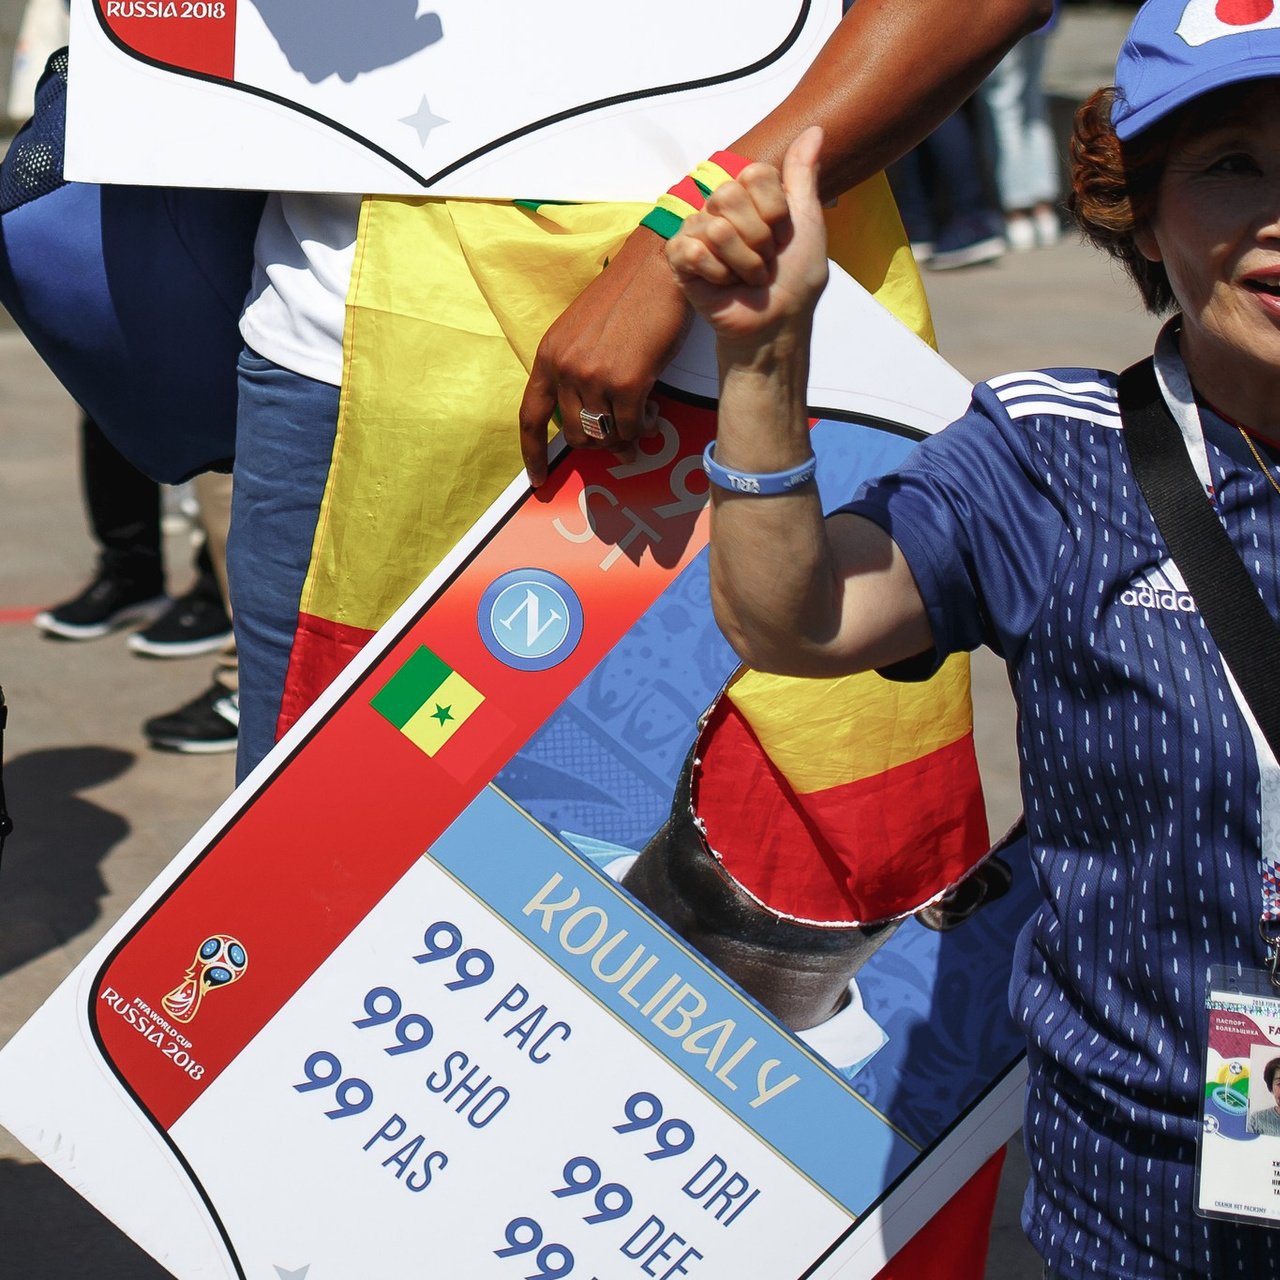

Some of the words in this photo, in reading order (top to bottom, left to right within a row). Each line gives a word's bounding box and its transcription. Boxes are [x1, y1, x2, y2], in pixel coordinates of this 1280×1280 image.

[107, 1, 178, 18] RUSSIA
[180, 1, 226, 19] 2018
[606, 416, 711, 519] 99
[551, 484, 663, 572] ST
[499, 588, 563, 648] N
[1120, 587, 1198, 613] adida
[100, 986, 166, 1048] RUSSIA
[161, 1041, 205, 1081] 2018
[133, 997, 152, 1017] FIFA
[148, 1010, 178, 1037] WORLD
[175, 1033, 193, 1049] CUP
[411, 920, 495, 992] 99
[484, 983, 571, 1064] PAC
[521, 872, 801, 1109] KOULIBALY
[1215, 1017, 1246, 1027] ПАСПОРТ
[351, 986, 434, 1057] 99
[425, 1050, 510, 1129] SHO
[291, 1050, 374, 1120] 99
[362, 1113, 449, 1193] PAS
[612, 1091, 695, 1162] 99
[681, 1153, 761, 1227] DRI
[493, 1216, 575, 1280] 99
[550, 1155, 633, 1225] 99
[619, 1214, 704, 1280] DEF
